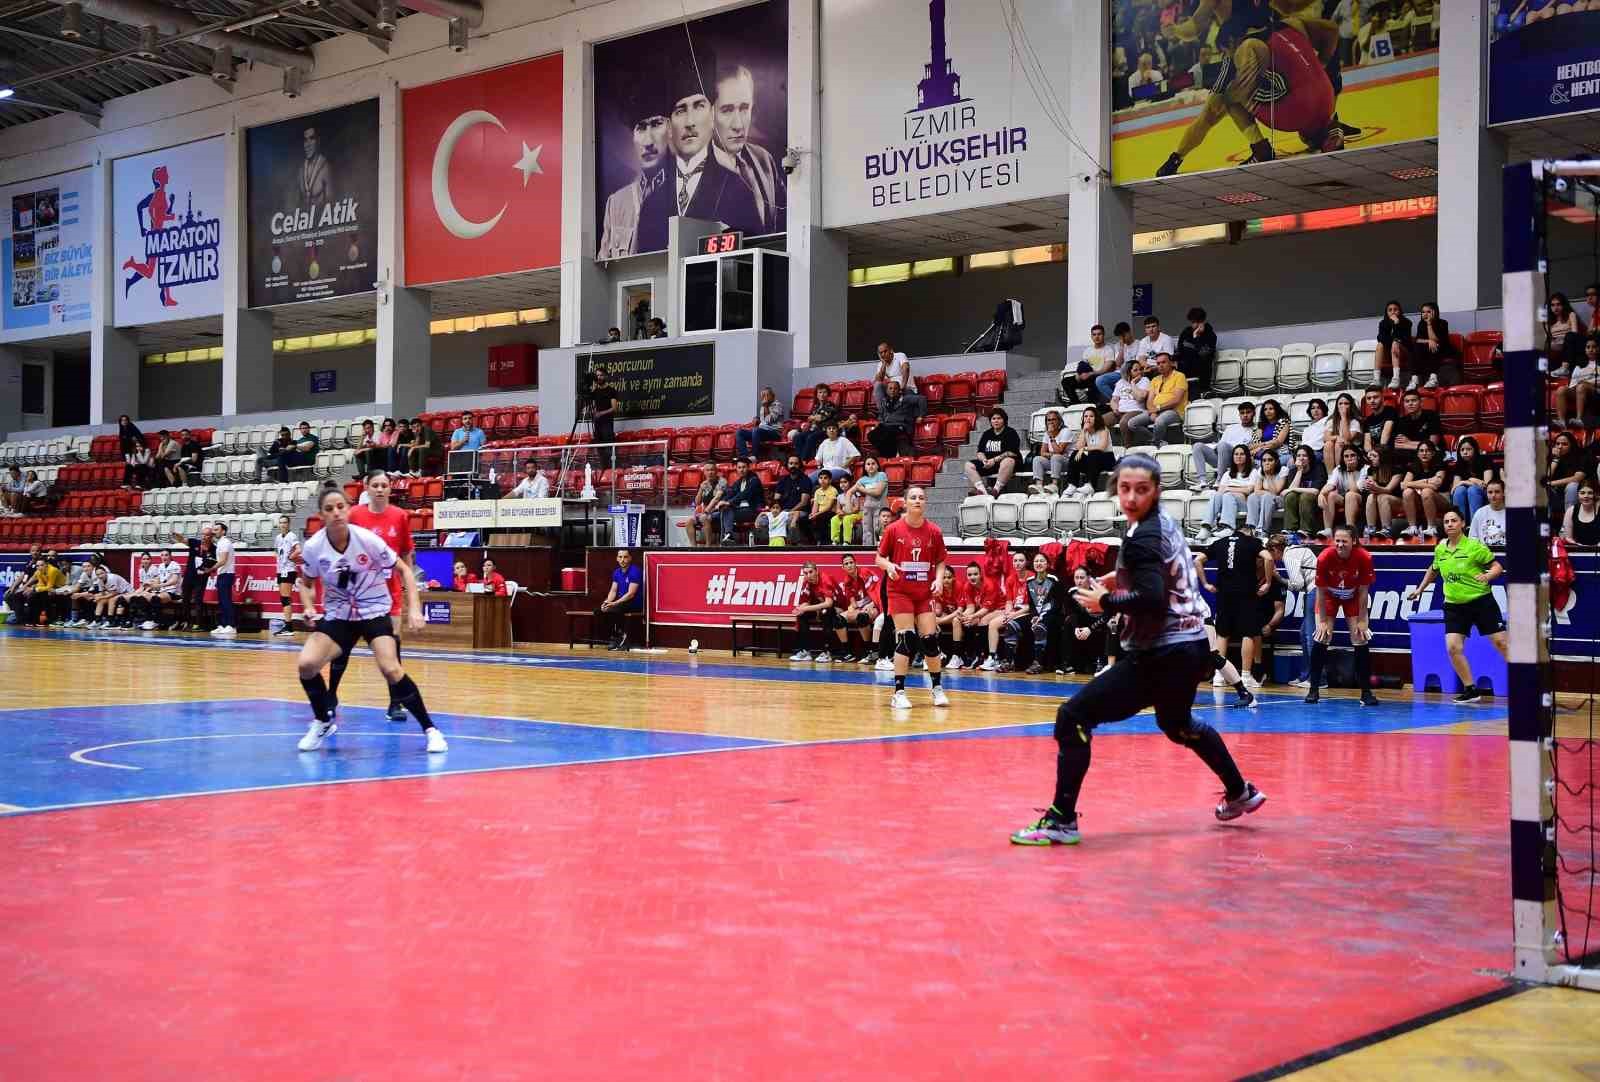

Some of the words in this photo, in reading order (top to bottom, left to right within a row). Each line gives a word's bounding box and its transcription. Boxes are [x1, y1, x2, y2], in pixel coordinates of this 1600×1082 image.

[903, 105, 977, 140] İZMİR
[865, 126, 1028, 180] BÜYÜKŞEHİR
[872, 158, 1020, 207] BELEDİYESİ
[271, 204, 316, 235] Celal
[318, 198, 358, 227] Atik
[147, 222, 219, 255] MARATON
[607, 358, 655, 375] sporcunun
[630, 378, 641, 390] ve
[663, 371, 704, 389] zamanda
[912, 547, 922, 561] 17
